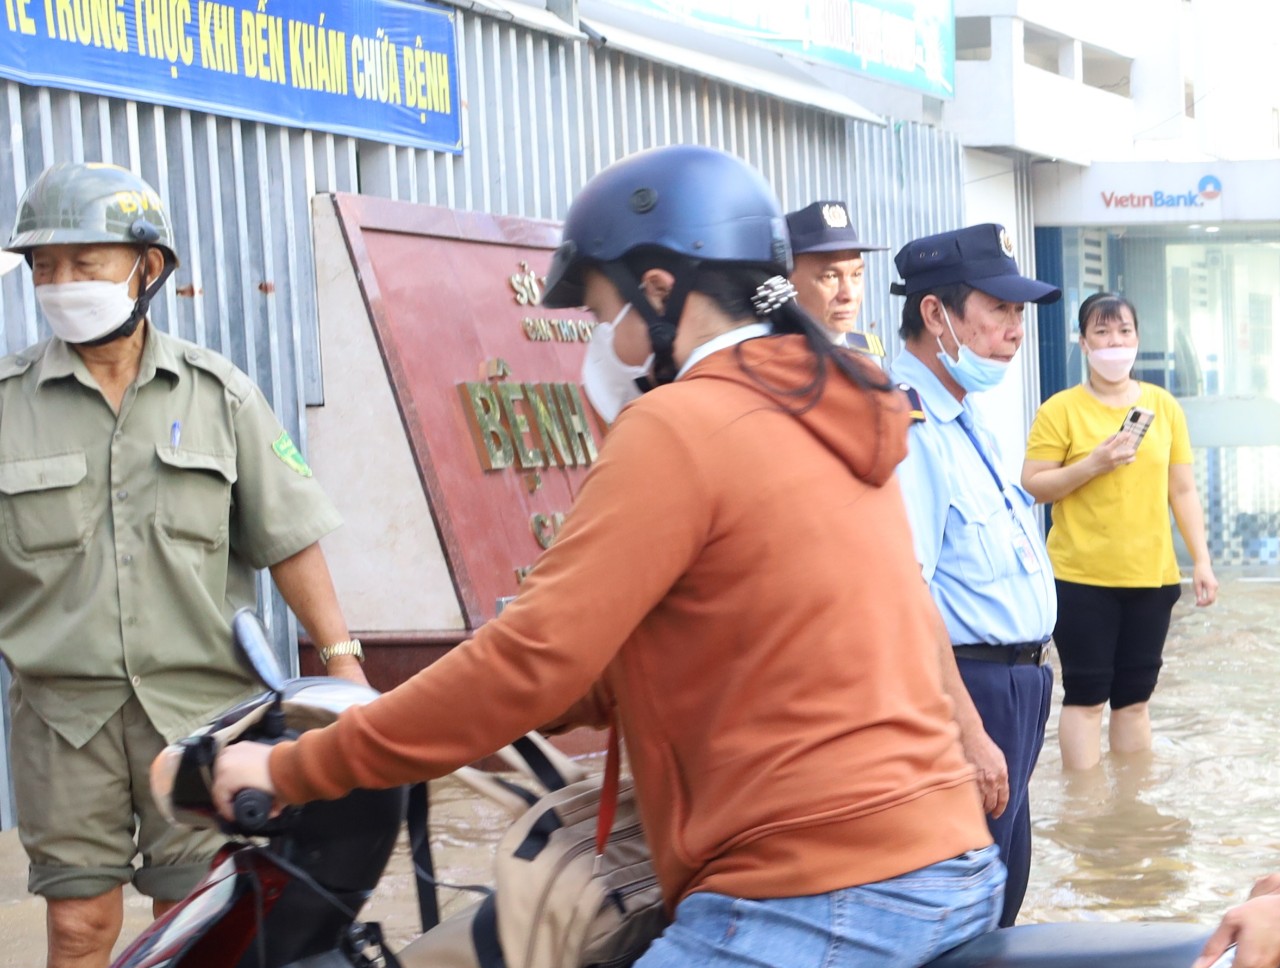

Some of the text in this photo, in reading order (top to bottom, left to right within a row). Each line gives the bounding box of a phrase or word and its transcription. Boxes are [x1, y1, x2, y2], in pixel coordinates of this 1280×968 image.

[198, 1, 239, 75] KHI
[288, 12, 348, 96] KHÁM
[351, 27, 402, 105] CHỮA
[403, 35, 451, 125] BỆNH
[461, 357, 599, 493] BỆNH
